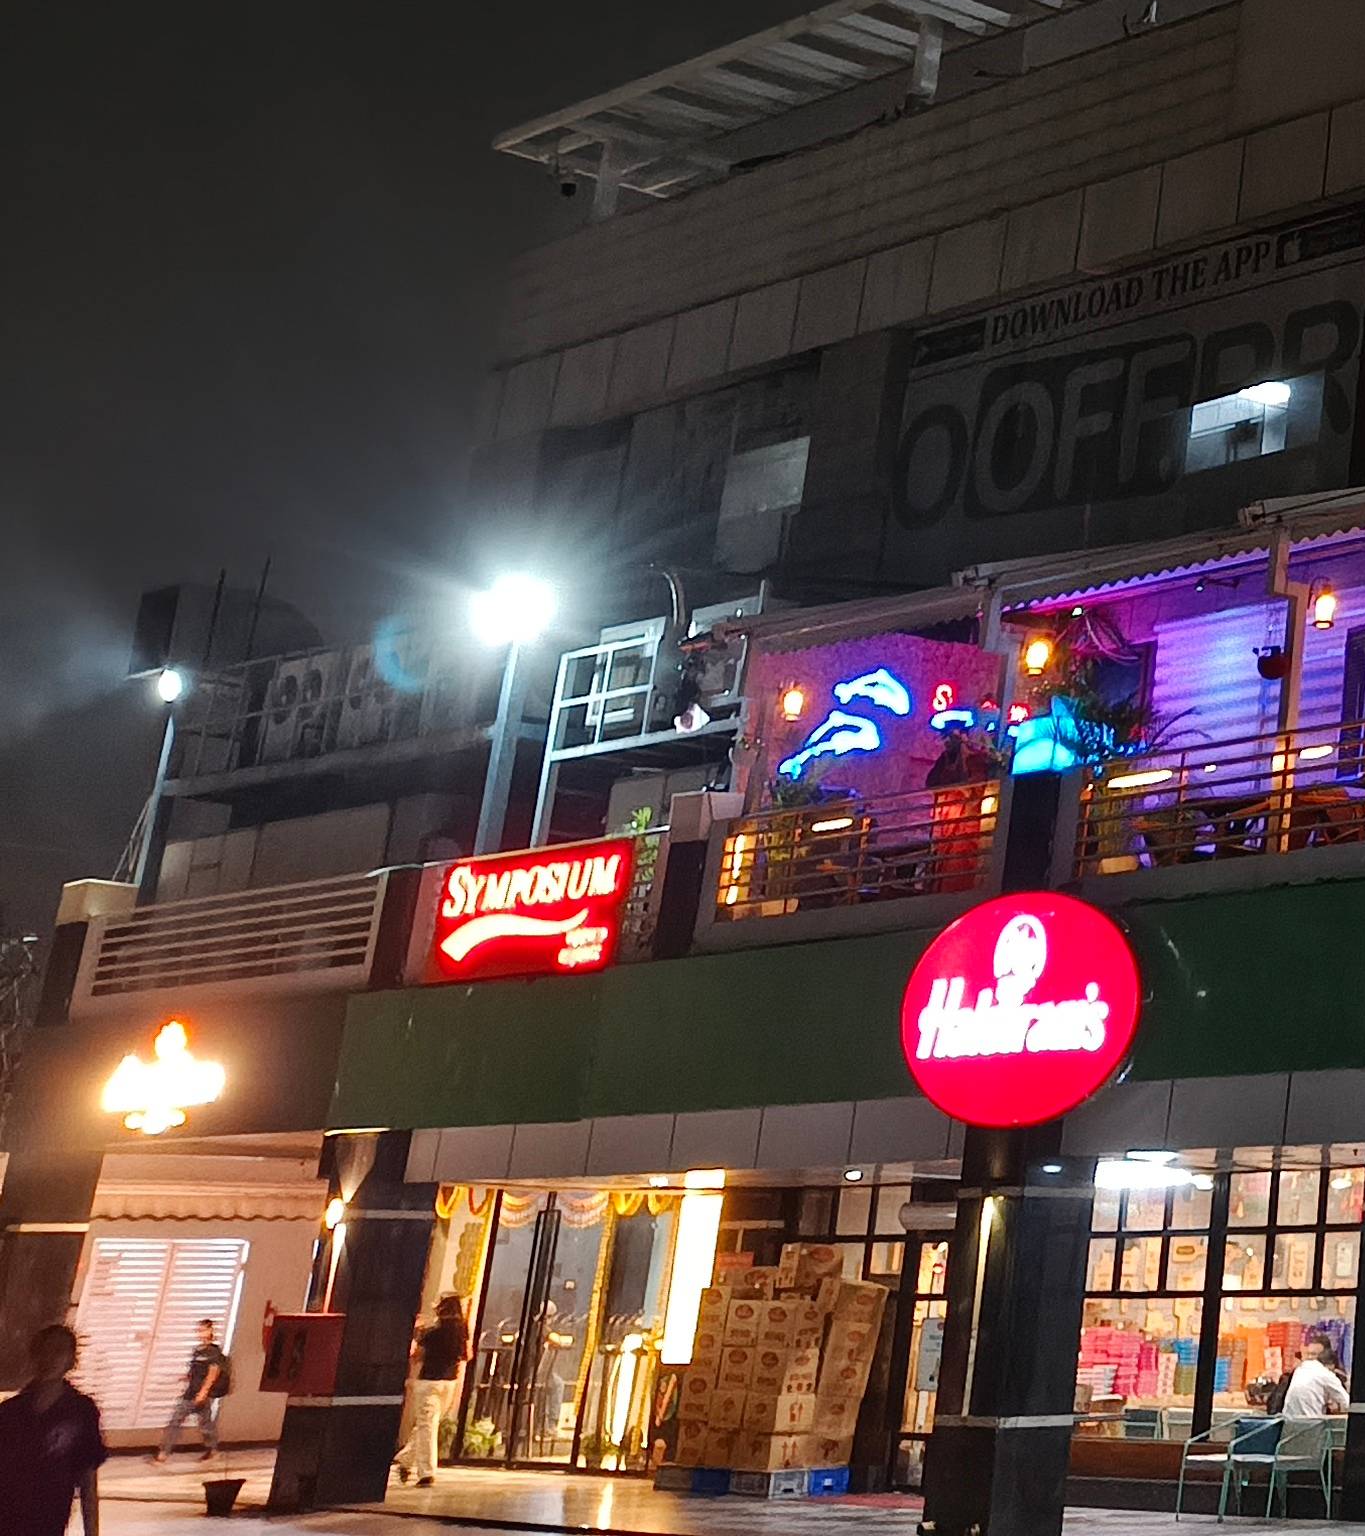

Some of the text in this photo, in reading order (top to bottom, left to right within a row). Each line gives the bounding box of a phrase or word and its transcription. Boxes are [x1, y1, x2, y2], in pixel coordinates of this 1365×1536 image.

[992, 240, 1272, 346] DOWNLOAD THE APP
[442, 854, 622, 918] SYMPOSIUM
